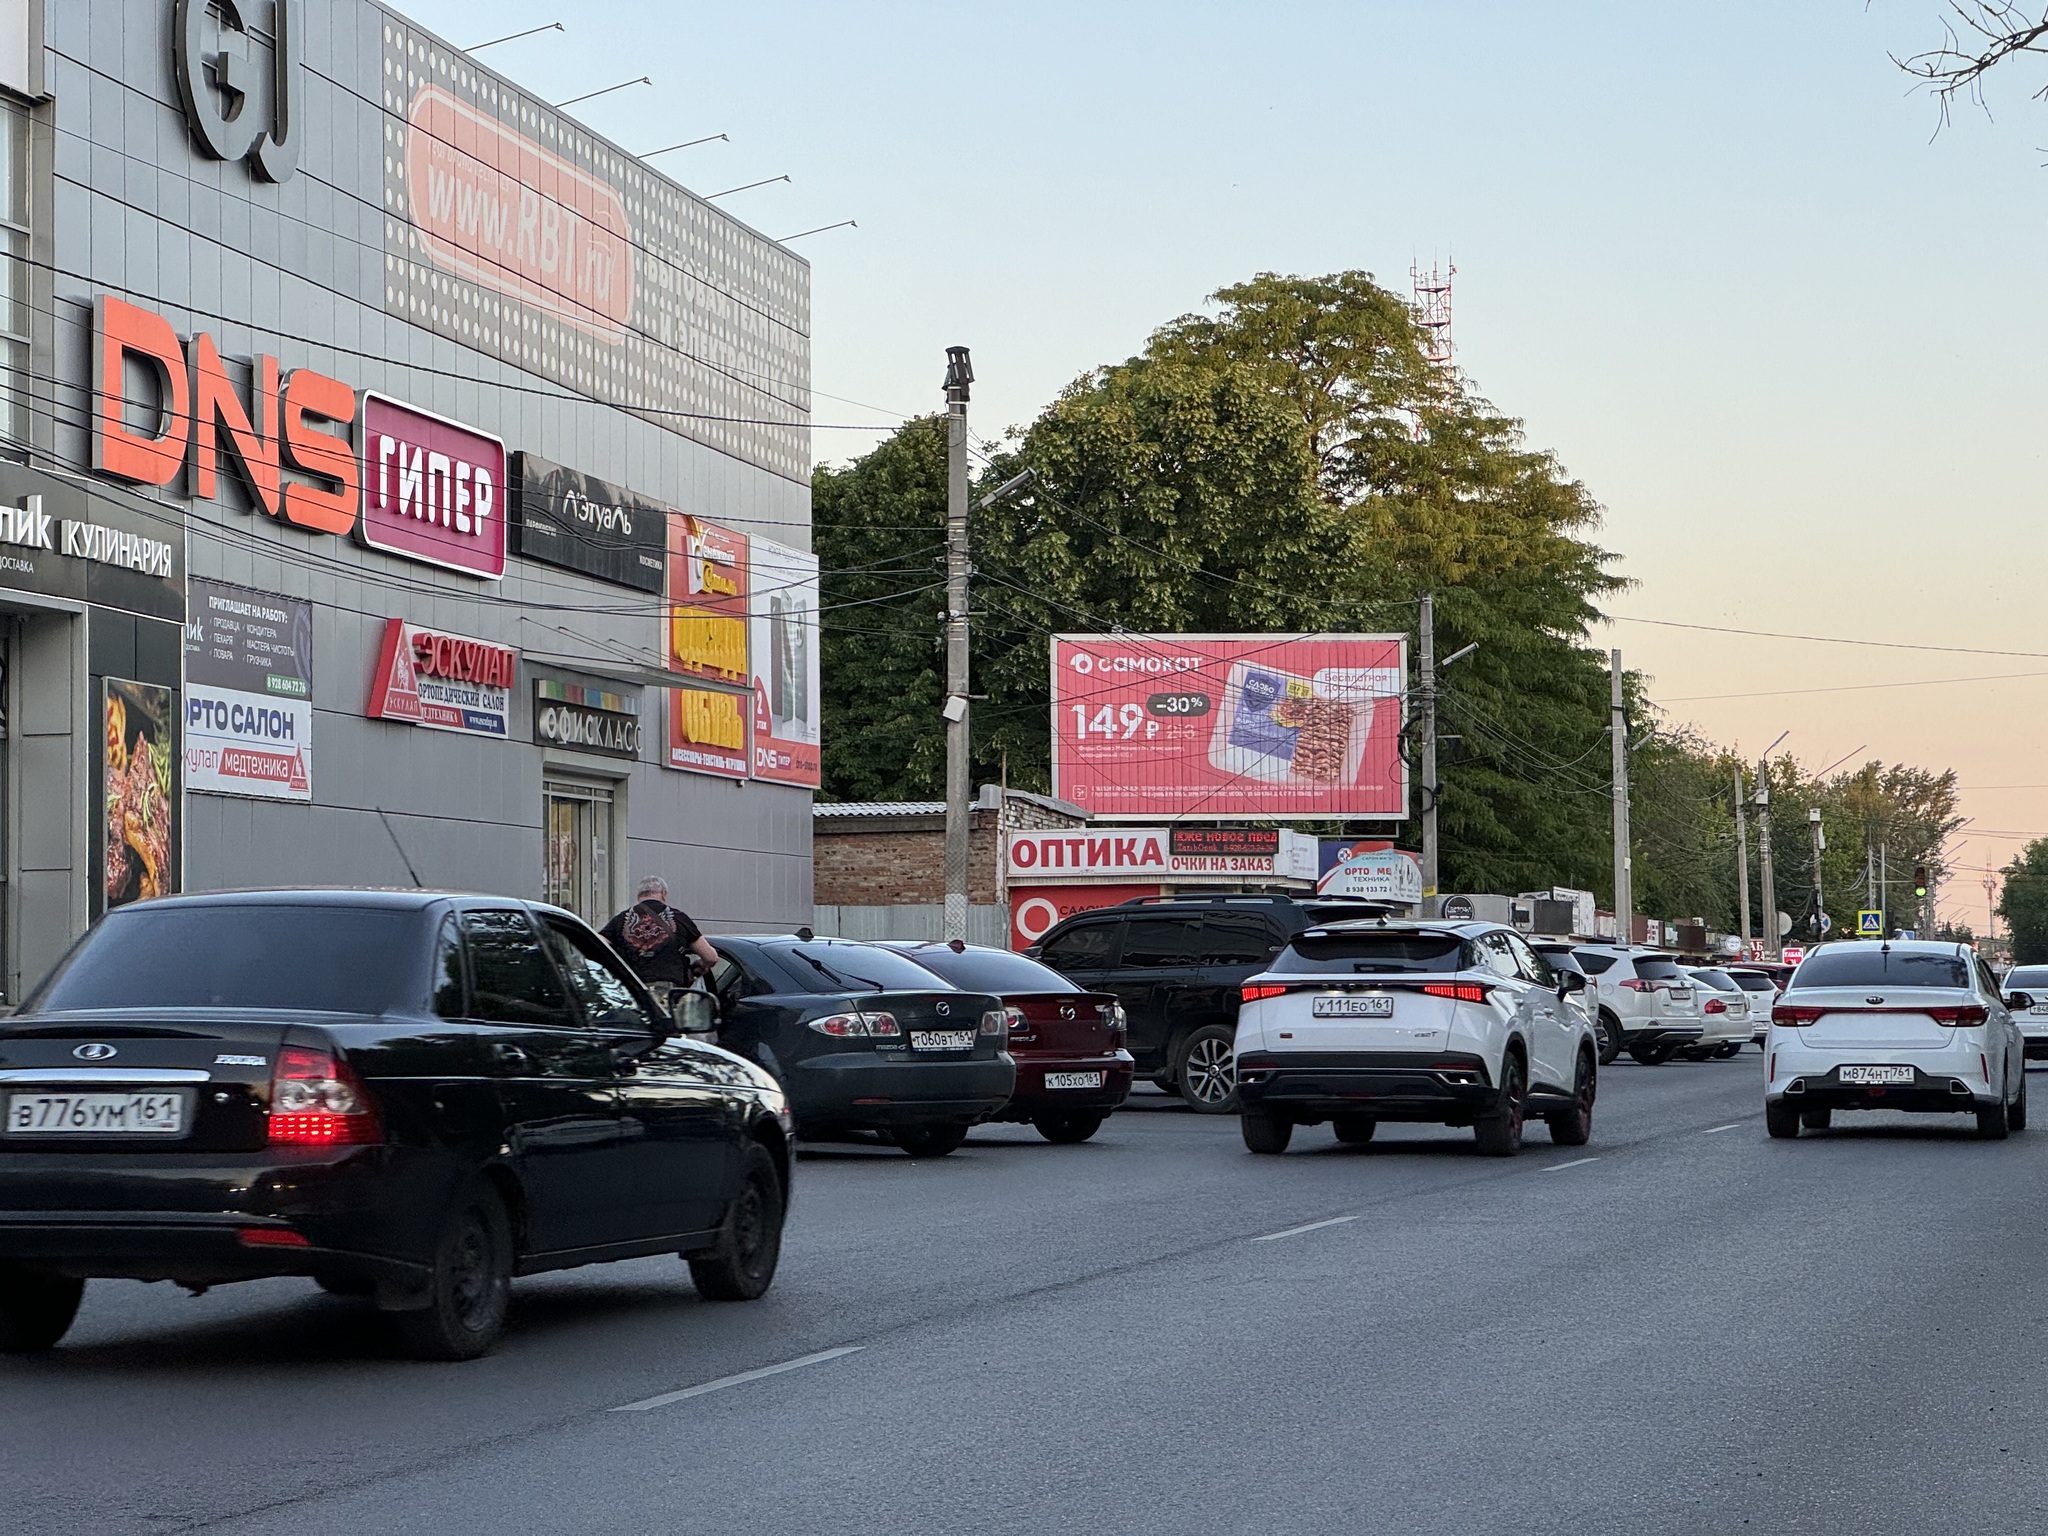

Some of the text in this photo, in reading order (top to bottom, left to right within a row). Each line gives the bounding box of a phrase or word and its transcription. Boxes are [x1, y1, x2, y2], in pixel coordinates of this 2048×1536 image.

[731, 289, 800, 357] ТЕХНИКА
[95, 295, 359, 535] DNS
[375, 435, 492, 537] ГИПЕР
[60, 519, 172, 578] КУЛИНАРИЯ
[0, 556, 34, 574] ОСТАВКА
[208, 595, 288, 624] ПРИГЛАШАЕТ НА РАБОТУ:
[213, 617, 240, 632] ПРОДАВЦА
[246, 624, 277, 639] КОНДИТЕРА
[213, 633, 234, 645] ПЕКАРЯ
[246, 639, 295, 657] МАСТЕРА ЧИСТОТЫ
[213, 648, 234, 661] ПОВАРА
[246, 653, 272, 668] ГРУЗЧИКА
[412, 632, 516, 689] ЭСКУЛАП
[1248, 679, 1275, 694] СЛОВО
[1324, 673, 1388, 683] Бесплатная
[417, 682, 505, 712] ОРТОПЕДИЧЕСКИЙ САЛОН
[1324, 683, 1375, 693] доставка
[388, 695, 418, 712] ЭСКУЛАП
[756, 690, 763, 715] 2
[1156, 696, 1203, 713] -30%
[231, 704, 294, 741] САЛОН
[540, 706, 643, 754] ОФИСКЛАСС
[224, 752, 289, 778] медтехника
[756, 747, 777, 769] DNS
[1011, 837, 1165, 869] ОПТИКА
[1171, 857, 1272, 871] ОЧКИ НА ЗАКАЗ
[1344, 867, 1370, 876] ОРТО
